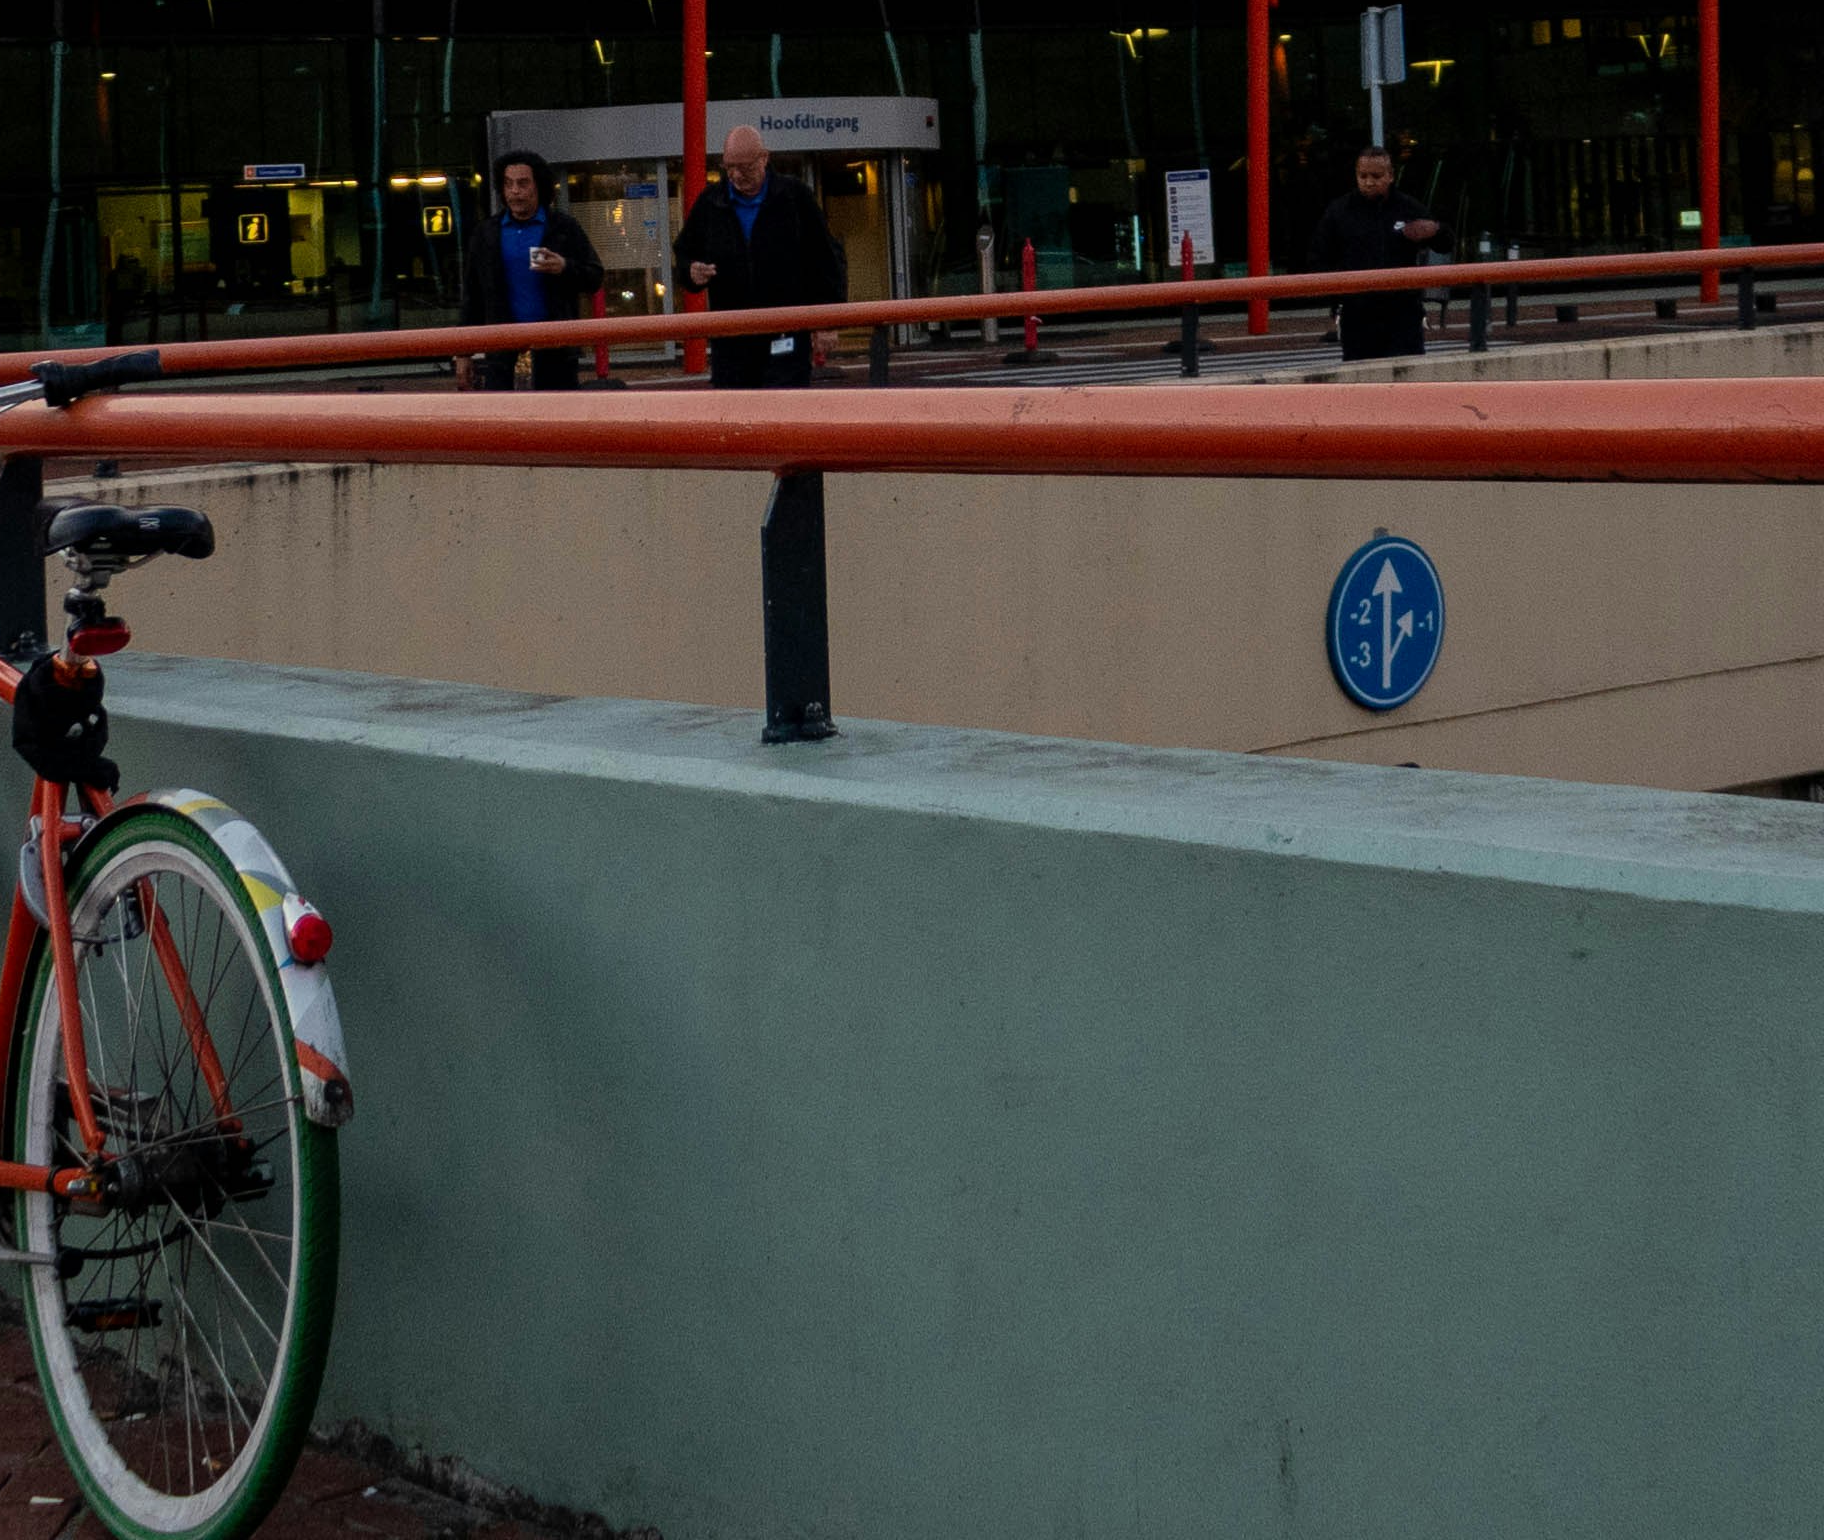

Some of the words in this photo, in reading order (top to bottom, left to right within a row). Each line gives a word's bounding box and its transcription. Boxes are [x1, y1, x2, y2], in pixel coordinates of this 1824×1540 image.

[760, 114, 860, 133] Hoofdingang
[1349, 598, 1372, 625] -2
[1418, 610, 1434, 632] -1
[1349, 641, 1372, 668] -3
